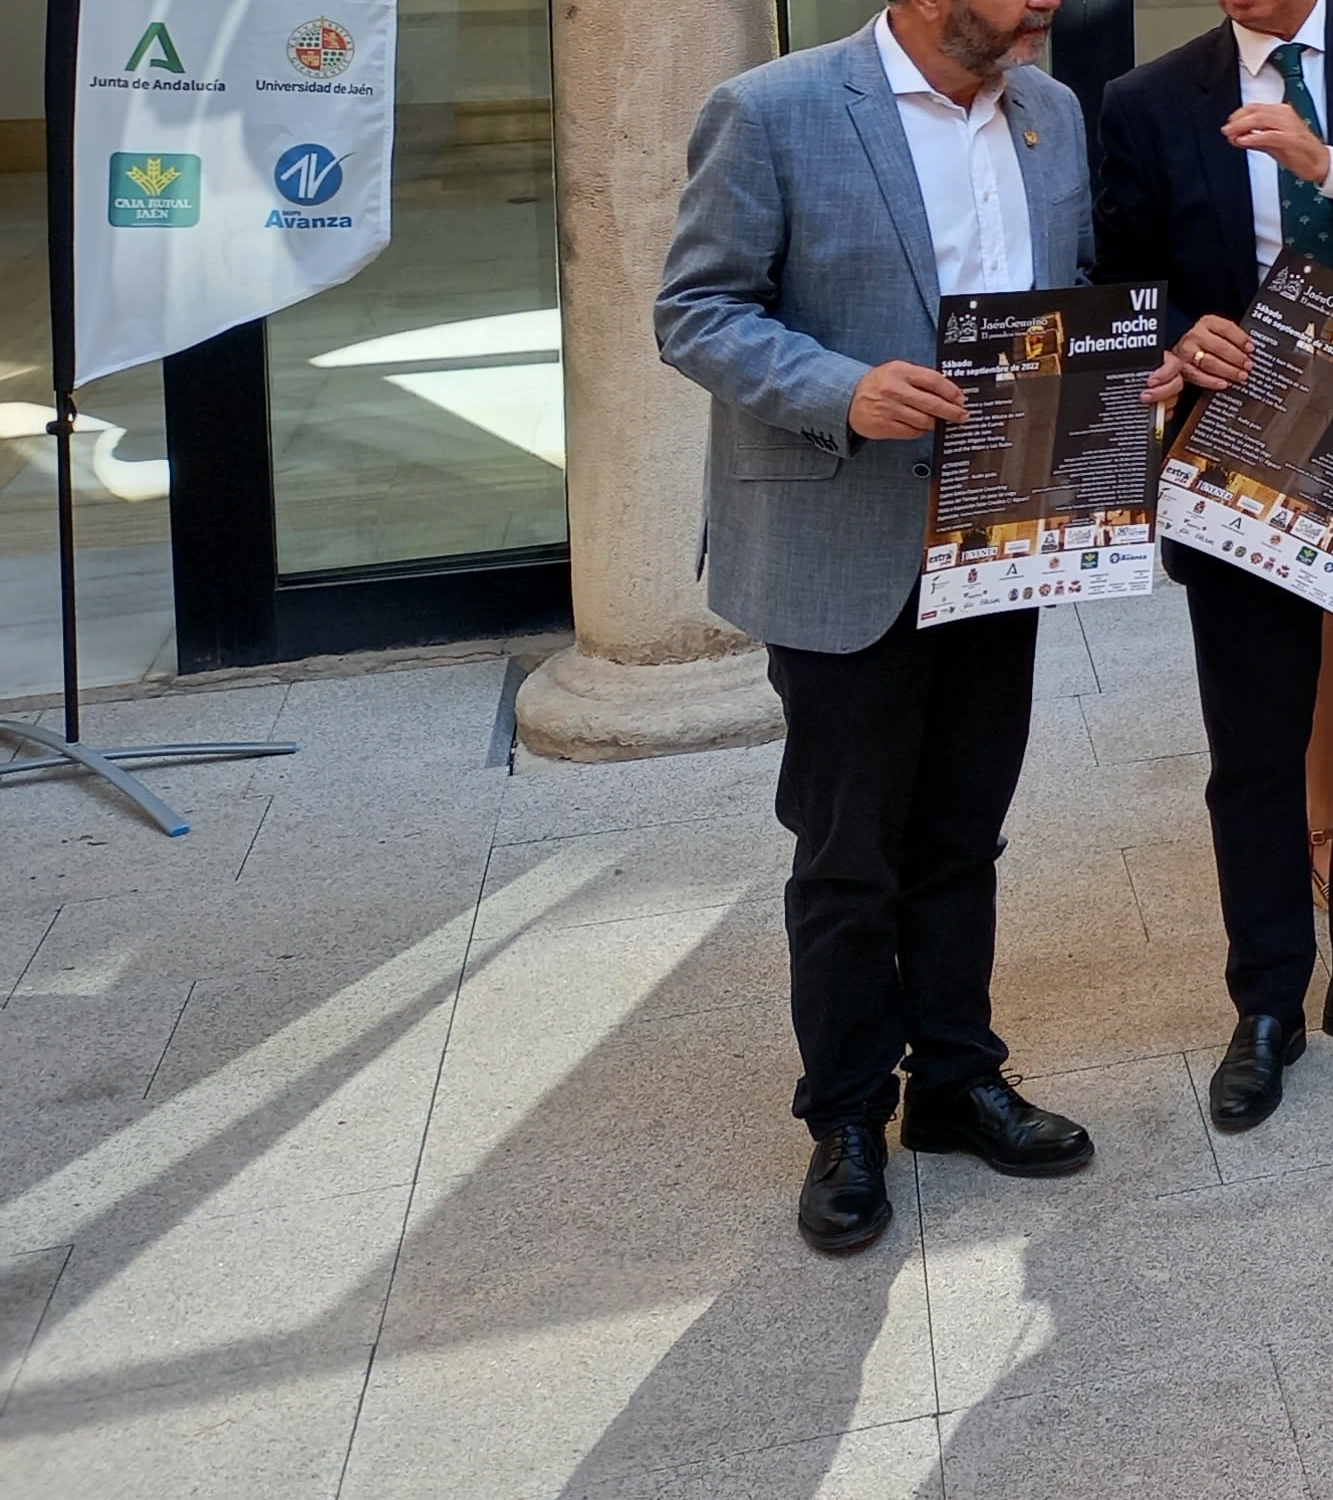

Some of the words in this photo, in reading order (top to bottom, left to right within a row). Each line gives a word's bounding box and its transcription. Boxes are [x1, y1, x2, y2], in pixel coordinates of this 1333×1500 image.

[89, 76, 129, 89] Junta
[132, 78, 150, 89] de
[152, 78, 226, 92] Andalucía
[256, 80, 331, 93] Universidad
[333, 83, 347, 94] de
[347, 84, 373, 96] Jaén
[264, 210, 352, 229] Avanza
[1130, 288, 1158, 311] VII
[1112, 315, 1158, 334] noche
[1262, 315, 1273, 324] de
[1272, 318, 1313, 343] septiembre
[1068, 334, 1158, 357] jahenciana
[941, 358, 972, 369] Sábado
[954, 368, 965, 376] de
[966, 364, 1010, 377] septiembre
[1011, 363, 1020, 372] de
[1021, 361, 1040, 371] 2022
